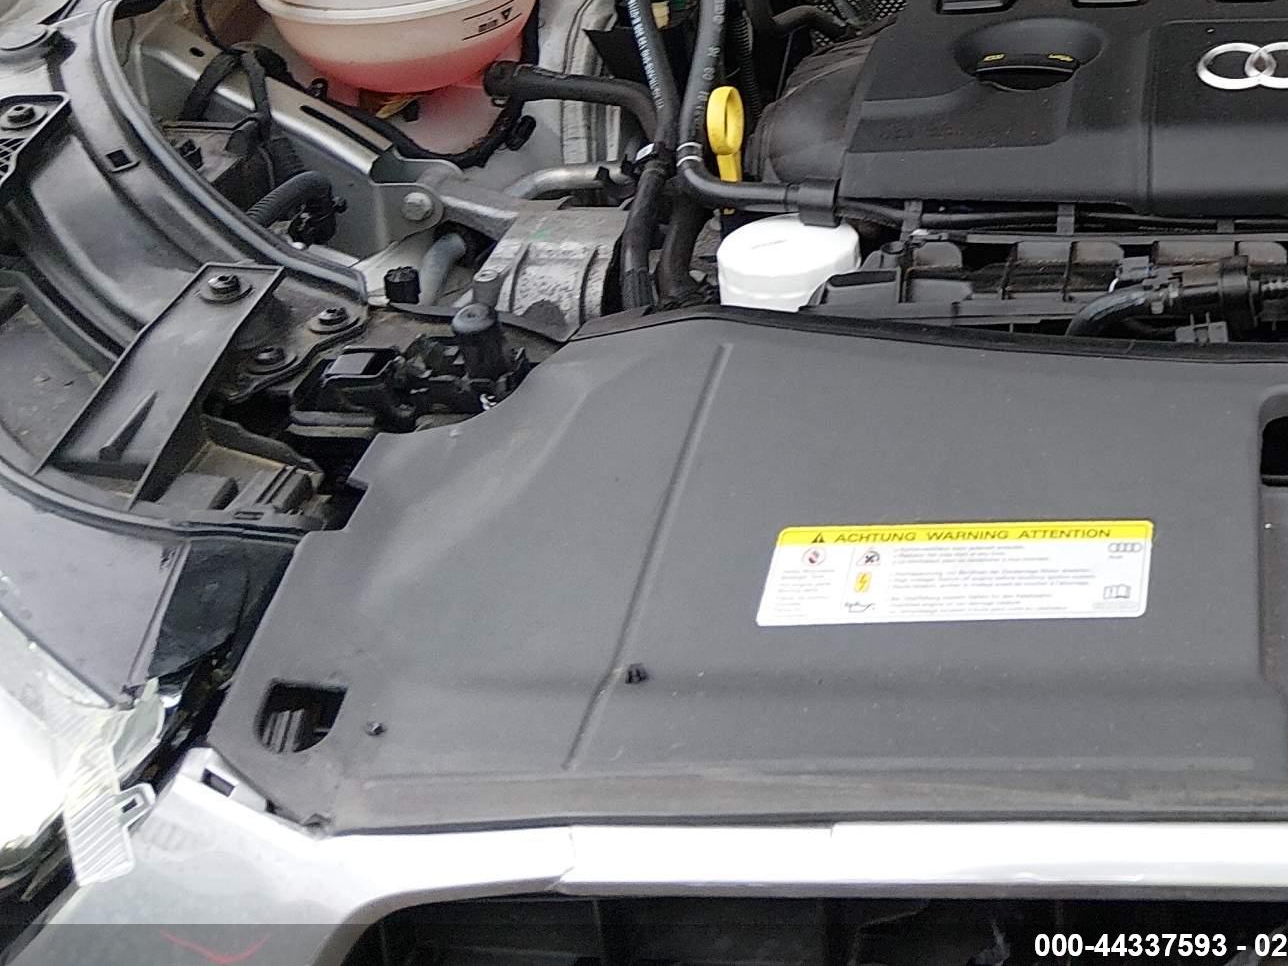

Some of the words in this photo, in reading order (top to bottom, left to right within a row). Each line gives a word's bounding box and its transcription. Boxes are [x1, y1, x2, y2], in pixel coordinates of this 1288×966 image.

[834, 532, 917, 543] ACHTUNG
[926, 530, 1009, 542] WARNING
[1018, 528, 1112, 539] ATTENTION
